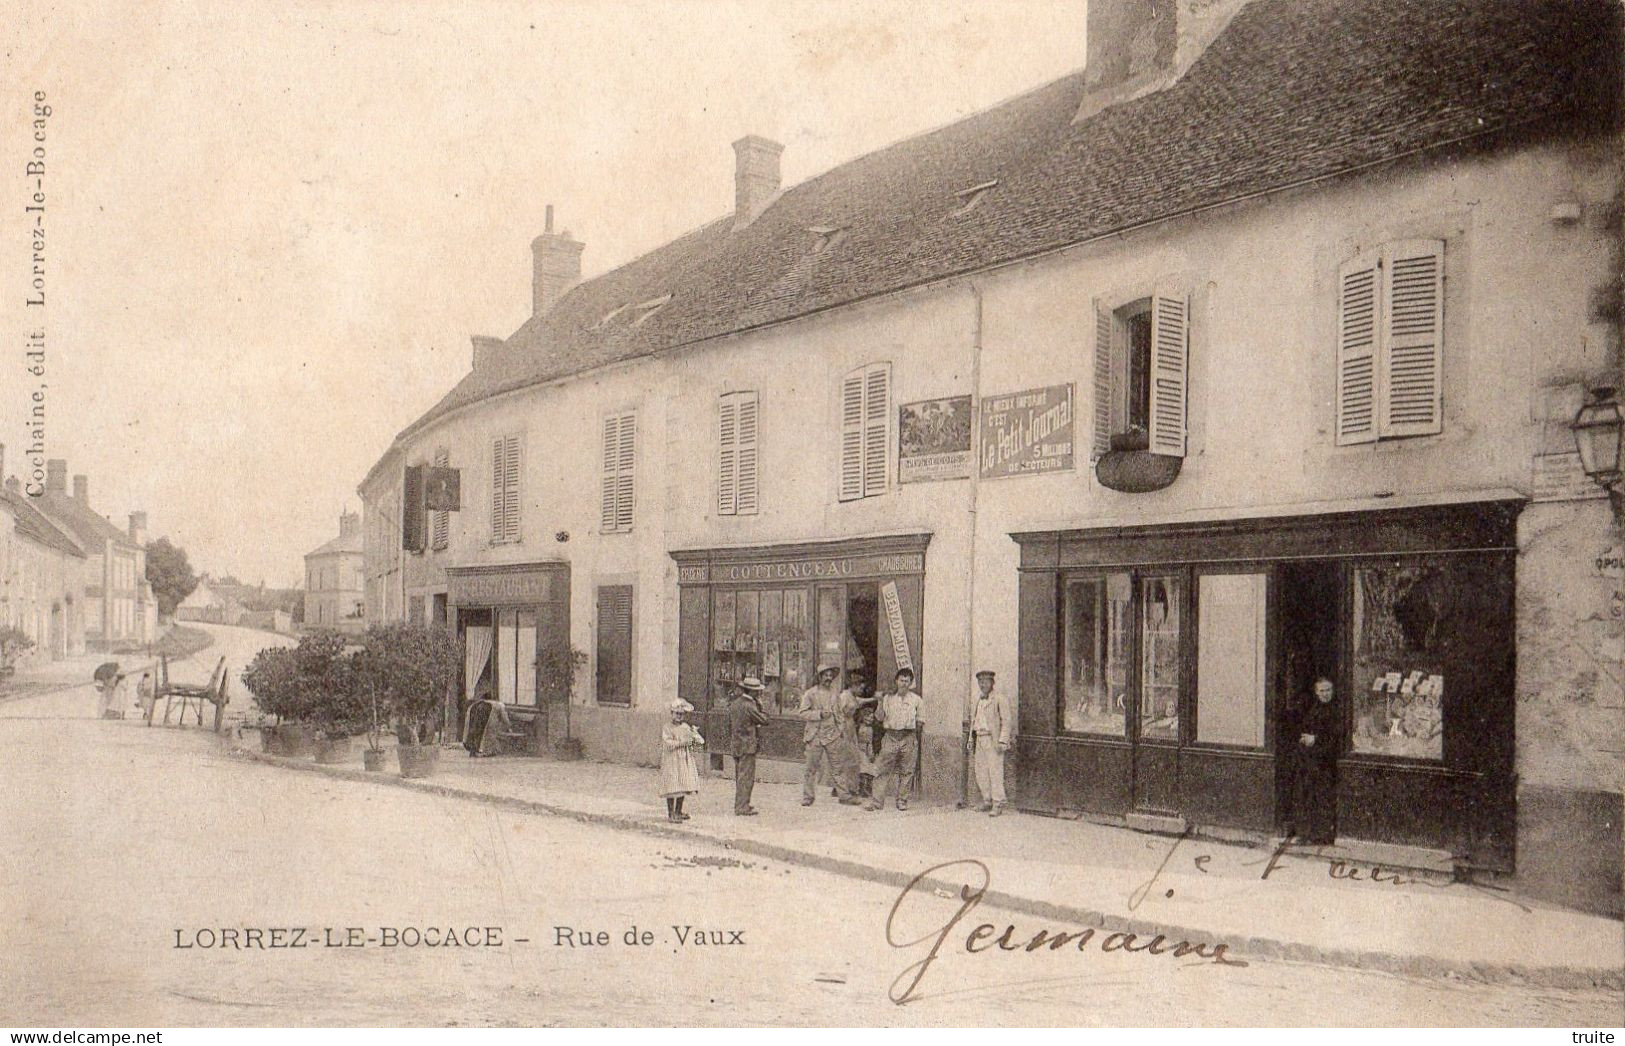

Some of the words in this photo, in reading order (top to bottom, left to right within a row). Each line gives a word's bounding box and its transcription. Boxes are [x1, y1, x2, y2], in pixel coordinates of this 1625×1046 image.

[982, 438, 995, 473] Le
[998, 417, 1023, 464] Petit
[1026, 387, 1071, 447] Journal
[1034, 445, 1041, 458] 5
[1009, 461, 1019, 472] DE
[730, 558, 852, 580] COTTENCEAU
[886, 859, 1249, 1005] Germaine
